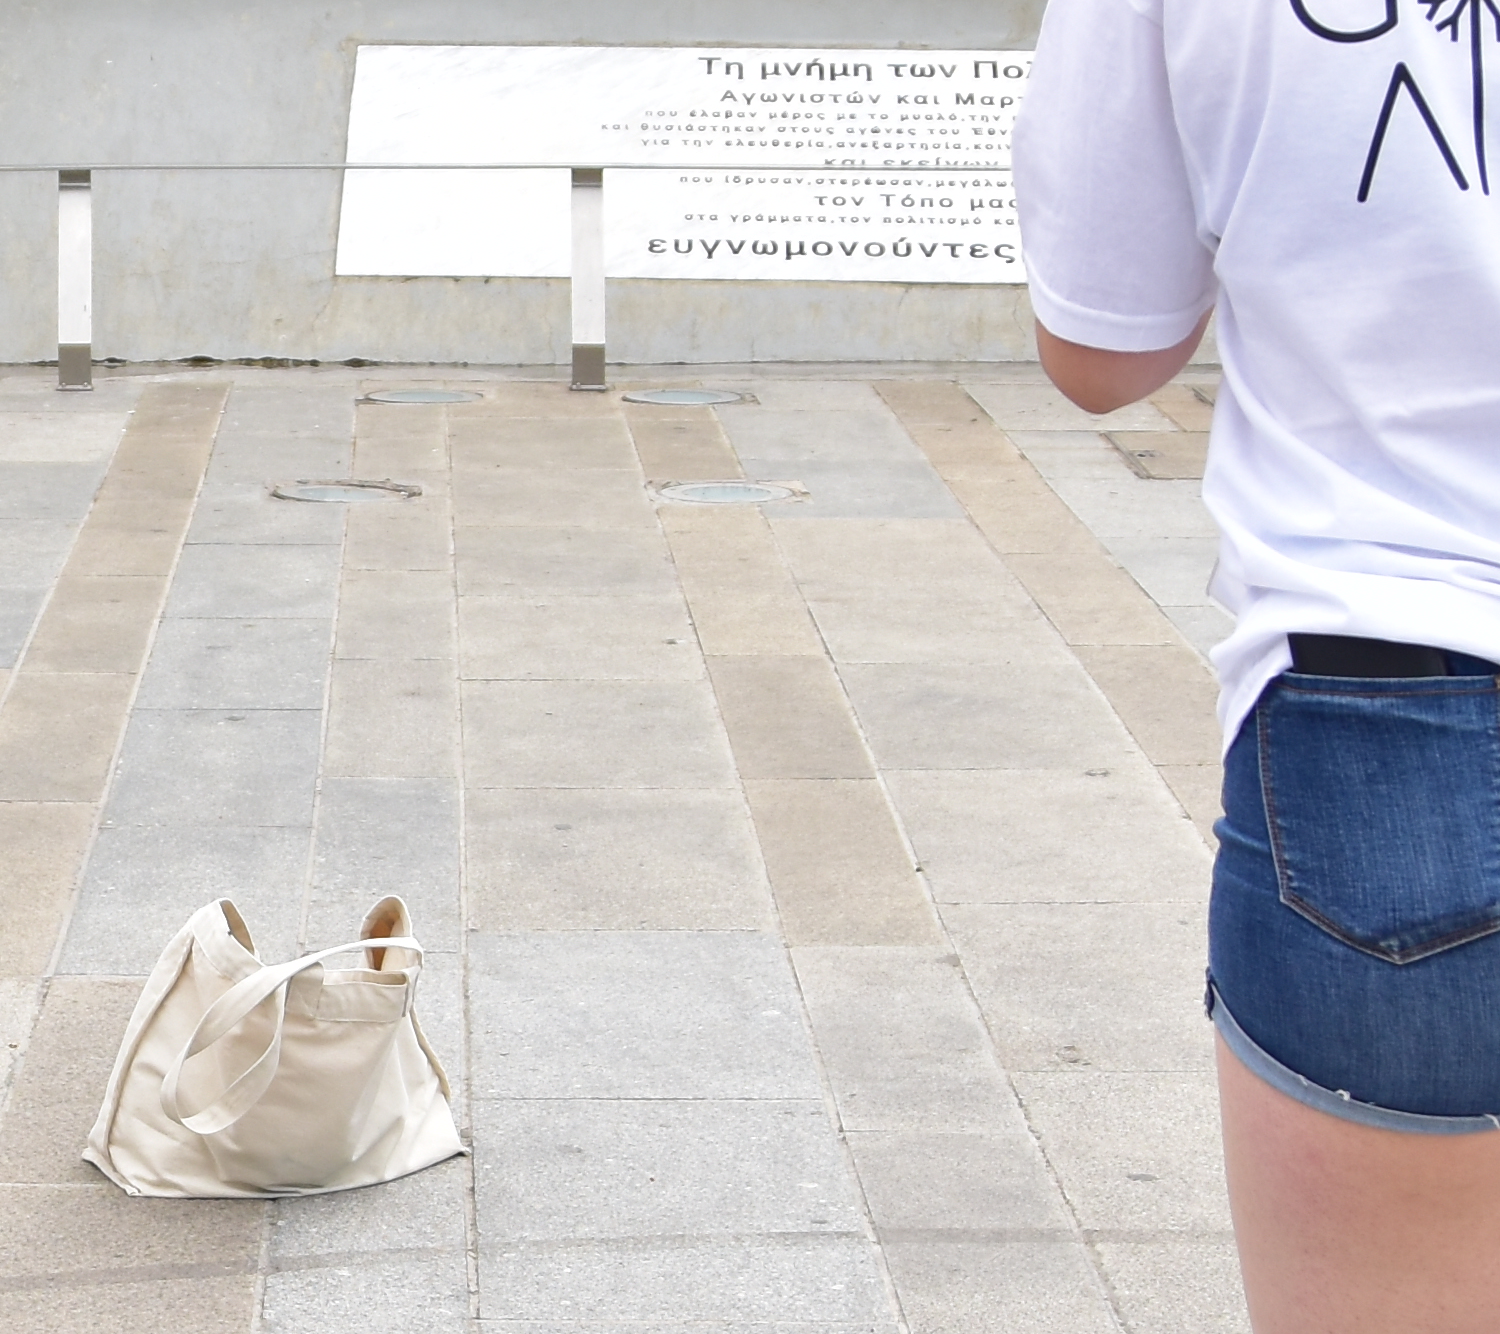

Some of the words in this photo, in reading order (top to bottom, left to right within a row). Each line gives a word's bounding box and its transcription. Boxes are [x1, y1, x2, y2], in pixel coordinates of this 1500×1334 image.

[698, 56, 744, 80] Τη
[760, 57, 873, 82] μνήμη
[886, 63, 958, 79] των
[720, 89, 882, 106] Αγωνιστών
[897, 94, 941, 106] και
[645, 109, 678, 118] που
[689, 109, 758, 120] έλαβαν
[768, 110, 826, 121] μέρος
[836, 112, 858, 122] με
[868, 113, 889, 121] το
[601, 123, 630, 132] και
[640, 122, 767, 134] θυσιάστηκαν
[777, 125, 835, 135] στους
[846, 126, 917, 137] αγώνες
[927, 128, 961, 136] του
[972, 127, 1012, 137] Έθν
[641, 138, 671, 147] για
[682, 139, 714, 148] την
[679, 175, 714, 184] που
[813, 195, 865, 207] τον
[879, 193, 954, 209] Τόπο
[684, 213, 719, 222] στα
[882, 216, 983, 226] πολιτισμό
[647, 236, 1017, 264] ευγνωμονούντες
